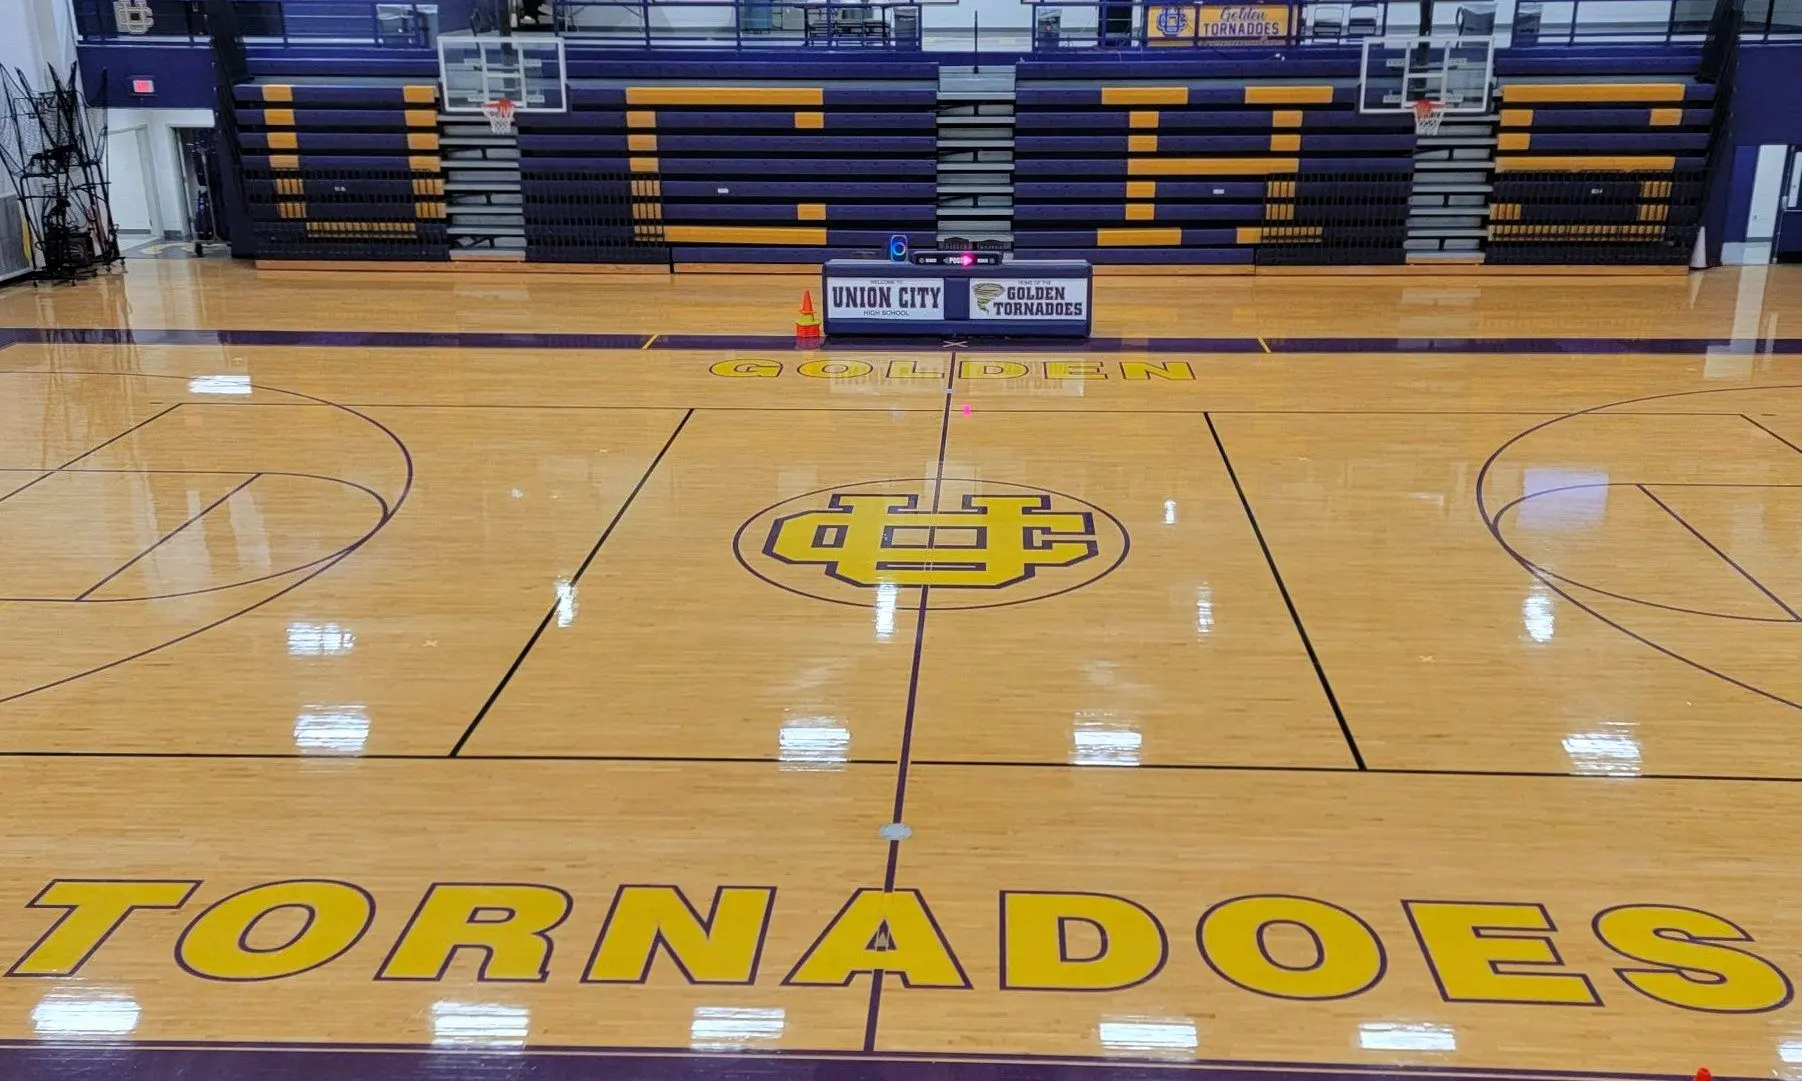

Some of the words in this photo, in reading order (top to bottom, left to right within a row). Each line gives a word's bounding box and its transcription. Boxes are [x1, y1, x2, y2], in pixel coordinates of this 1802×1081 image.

[1220, 6, 1266, 22] Golden
[1203, 22, 1280, 36] TORNADOES
[832, 286, 892, 308] UNION
[899, 286, 941, 309] CITY
[1007, 286, 1066, 300] GOLDEN
[993, 302, 1083, 316] TORNADOES
[709, 358, 1197, 382] GOLDEN
[3, 877, 1796, 1016] TORNADOES
